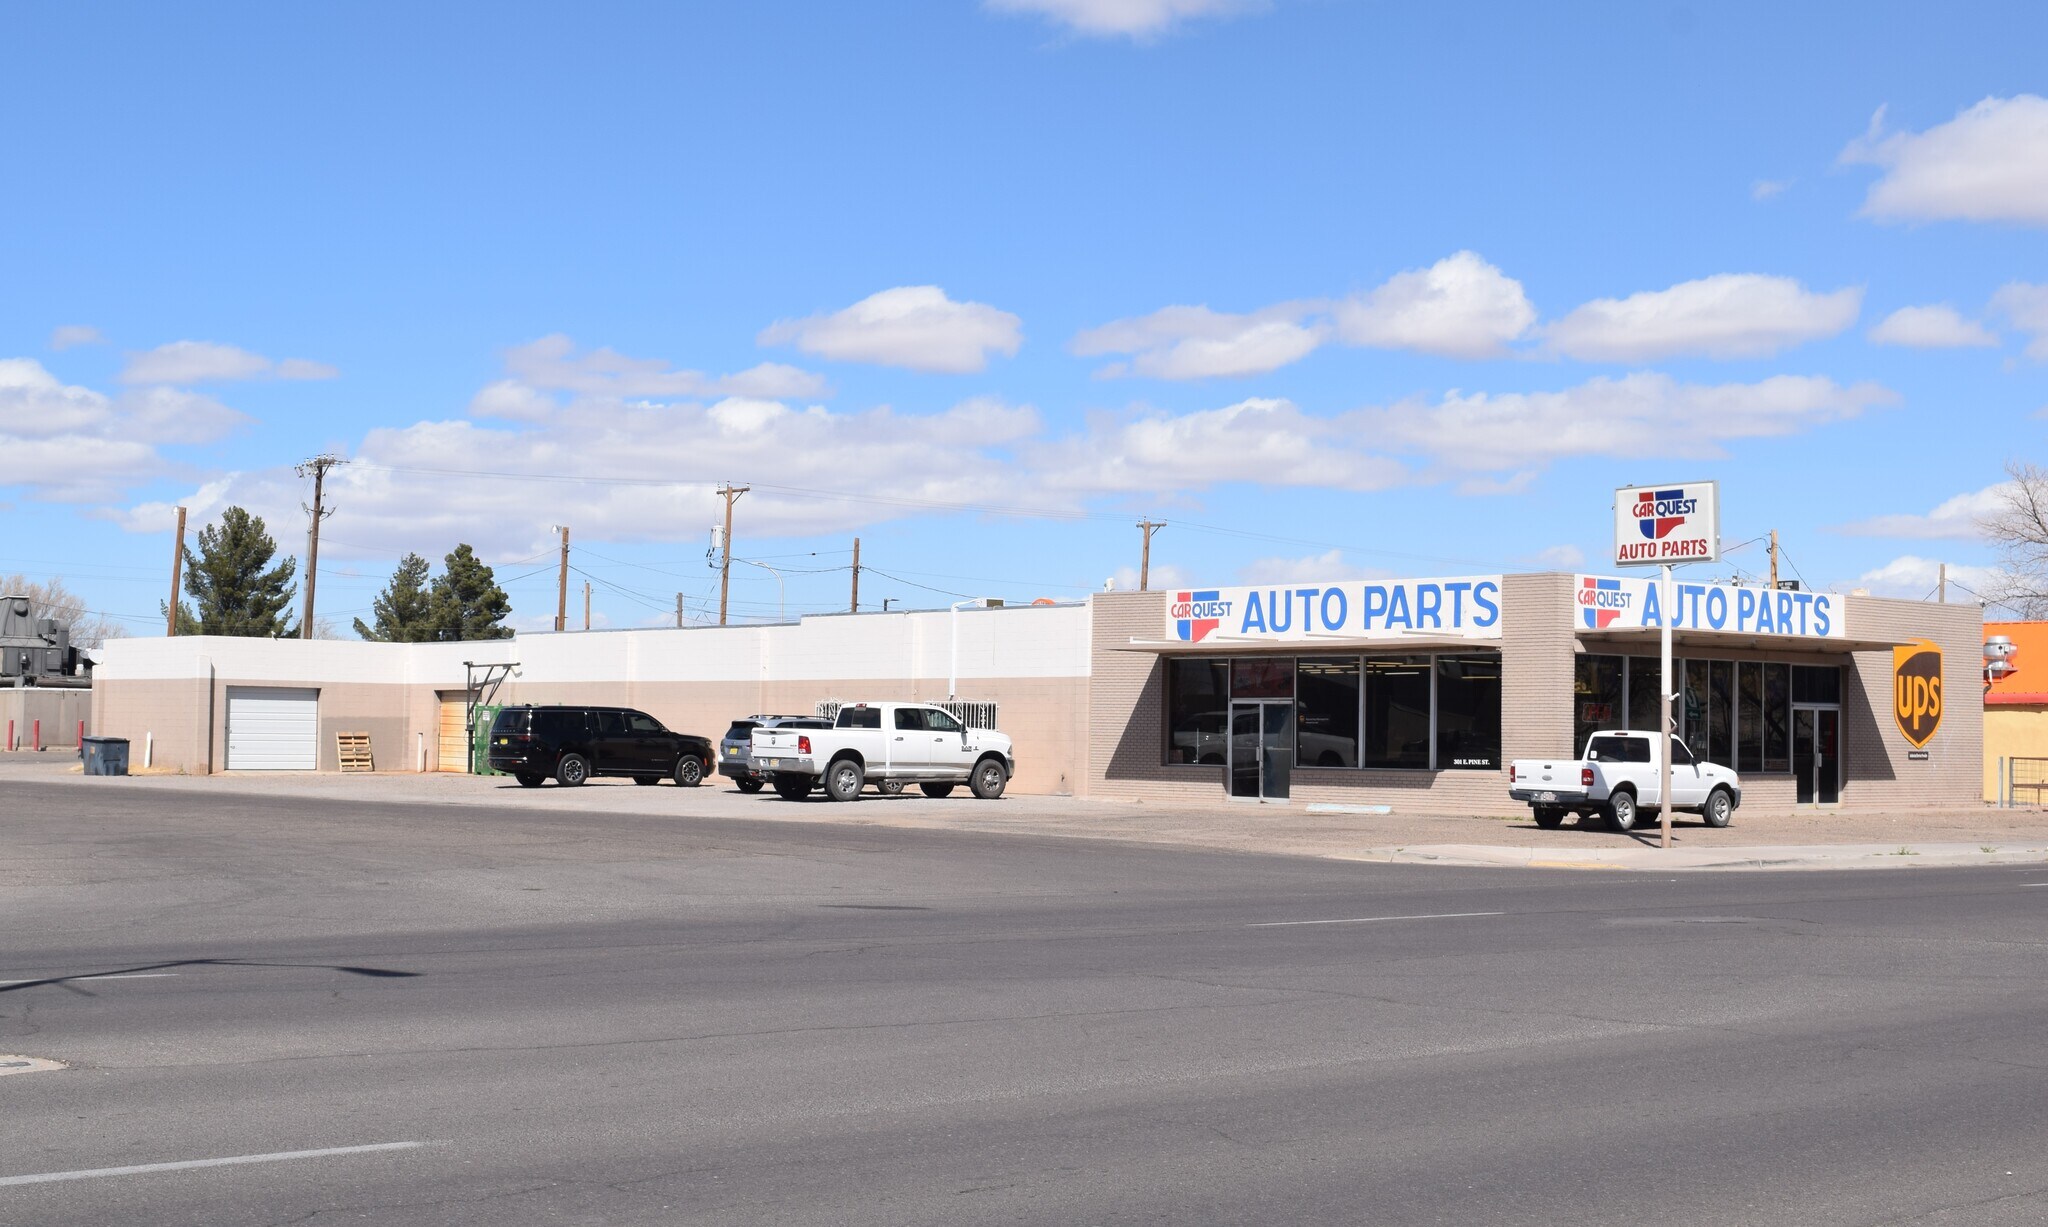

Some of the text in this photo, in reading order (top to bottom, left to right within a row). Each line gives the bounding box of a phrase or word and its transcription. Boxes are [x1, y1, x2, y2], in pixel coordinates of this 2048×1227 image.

[1619, 538, 1708, 560] AUTO PARTS
[1240, 581, 1499, 634] AUTO PARTS
[1640, 581, 1831, 637] AUTO PARTS
